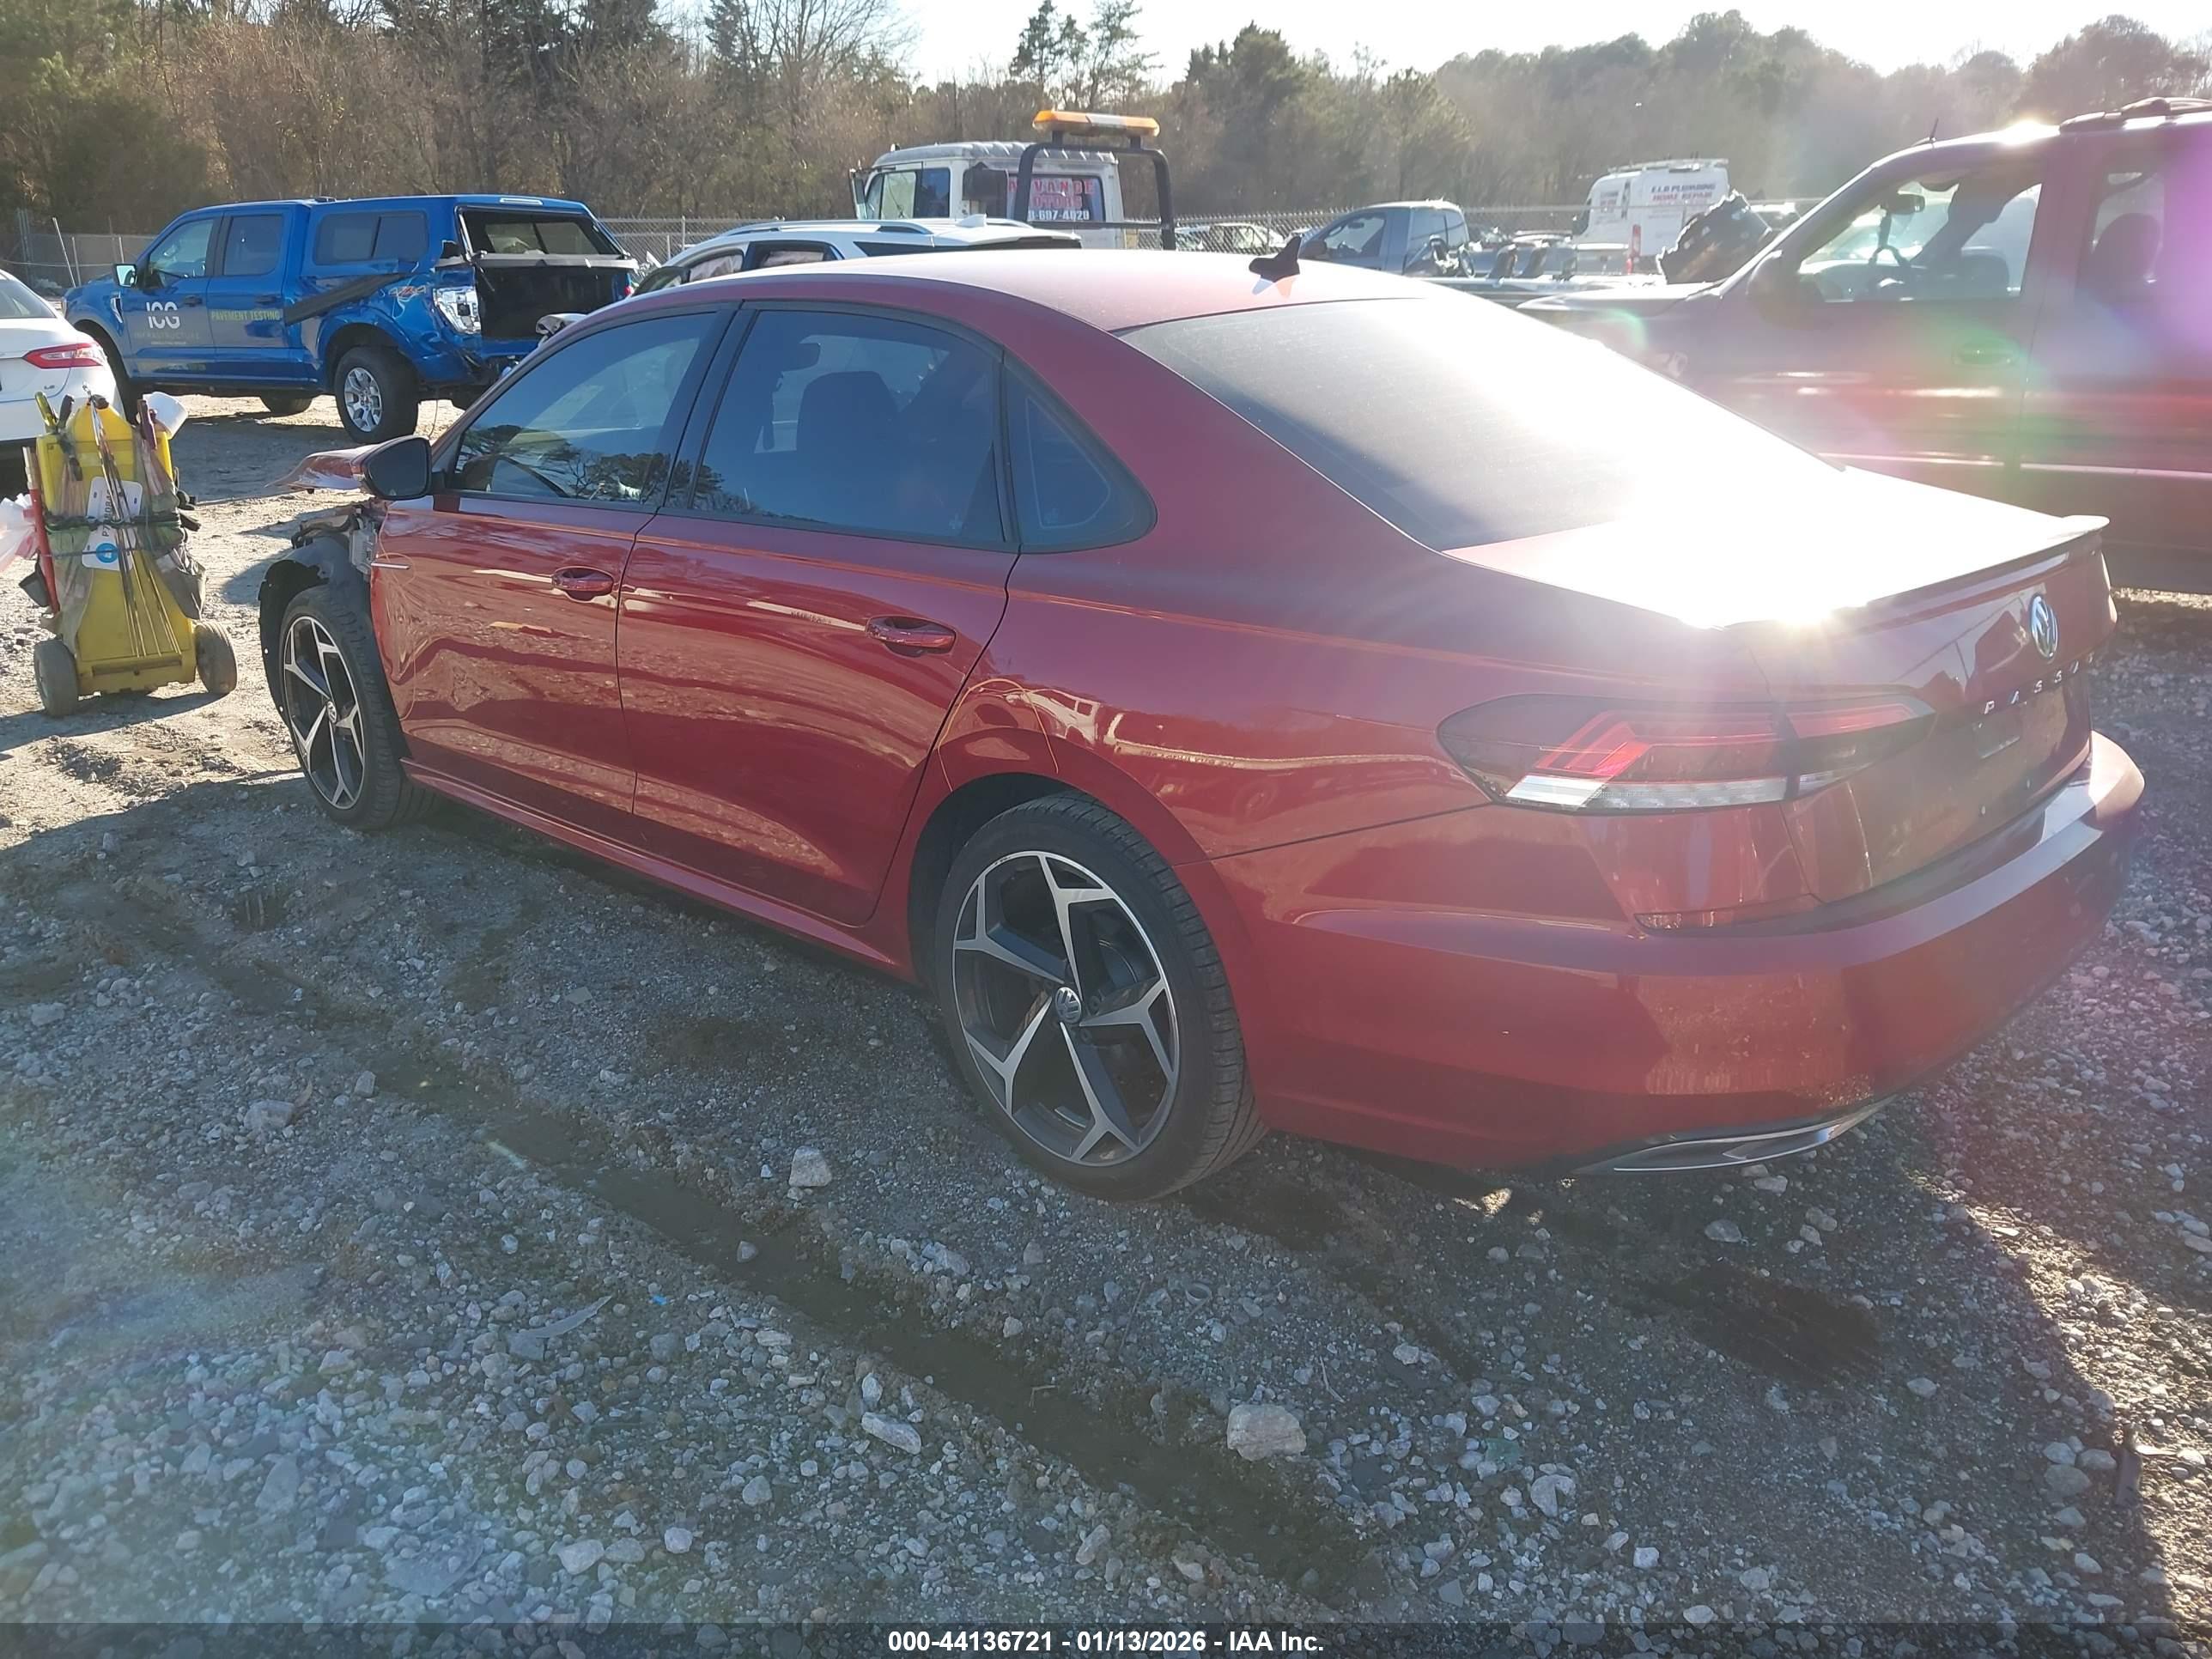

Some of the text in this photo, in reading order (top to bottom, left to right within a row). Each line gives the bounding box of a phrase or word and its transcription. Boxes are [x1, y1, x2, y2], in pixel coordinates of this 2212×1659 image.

[211, 309, 281, 321] PAVEMENT TESTING
[1984, 651, 2095, 714] PASSAT
